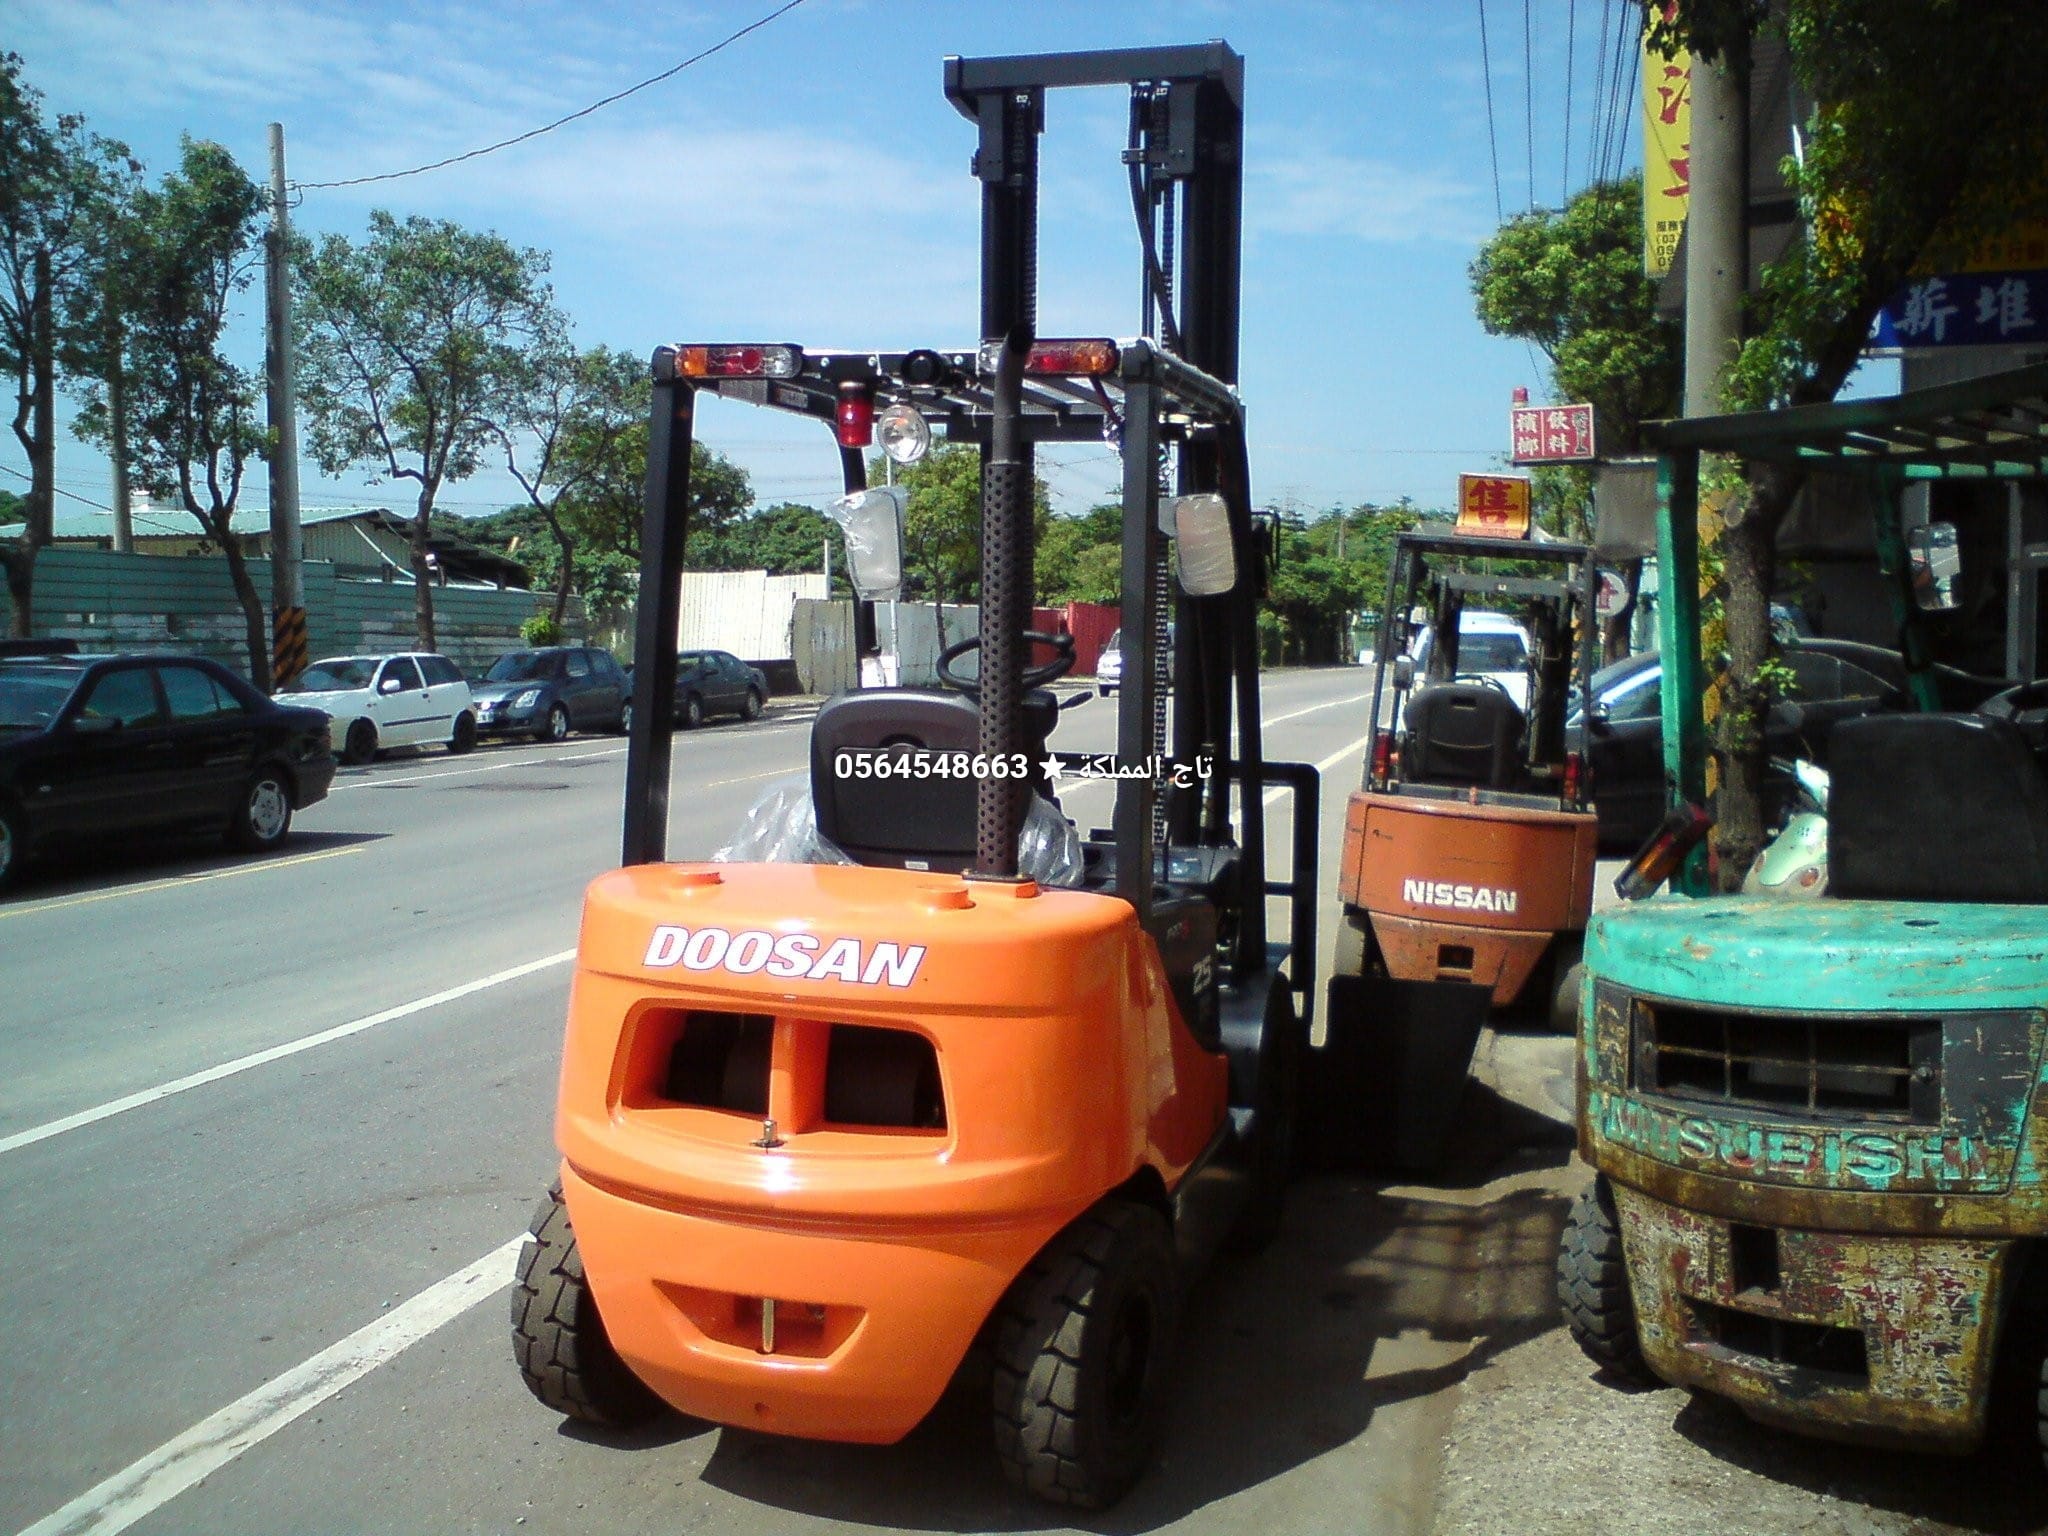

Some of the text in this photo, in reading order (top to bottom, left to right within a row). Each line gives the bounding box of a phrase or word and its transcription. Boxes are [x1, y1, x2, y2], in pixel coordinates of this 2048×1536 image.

[1868, 276, 2036, 341] 新堆
[1402, 878, 1518, 913] NISSAN
[642, 924, 927, 987] DOOSAN
